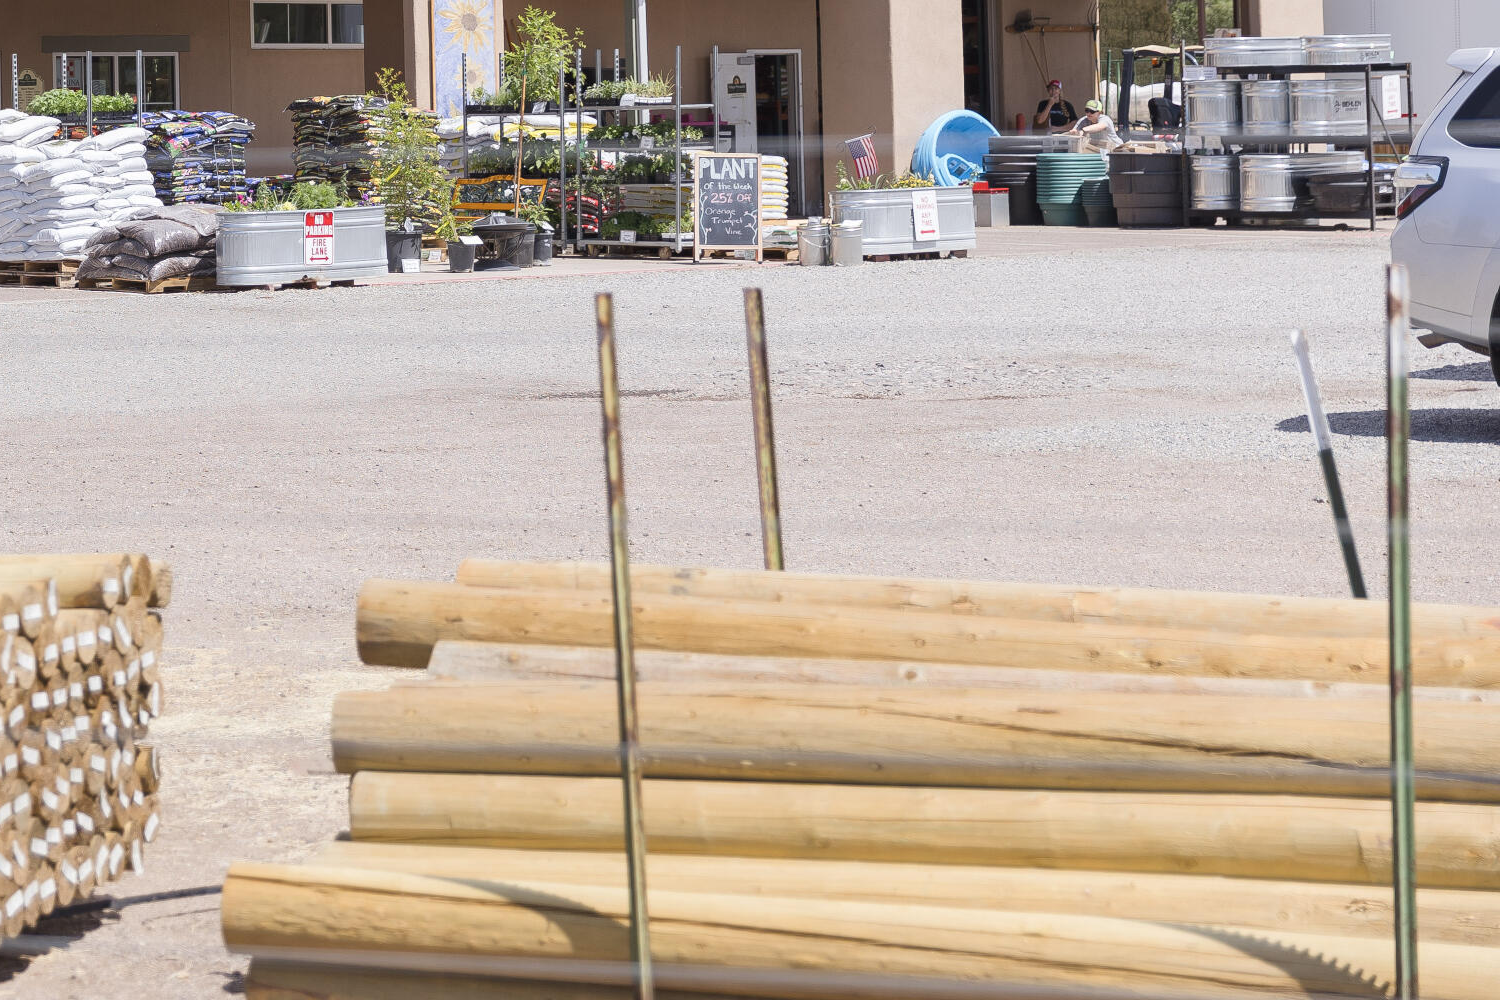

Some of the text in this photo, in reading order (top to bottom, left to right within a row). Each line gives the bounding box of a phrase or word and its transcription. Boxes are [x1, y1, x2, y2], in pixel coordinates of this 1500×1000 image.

[699, 158, 757, 180] PLANT
[710, 192, 734, 204] 25%
[704, 207, 737, 220] Orange
[314, 214, 324, 225] NO
[710, 216, 743, 227] Trumpet
[305, 225, 333, 236] PARKING
[725, 227, 743, 235] Vine
[312, 238, 327, 247] FIRE
[311, 247, 328, 256] LANE
